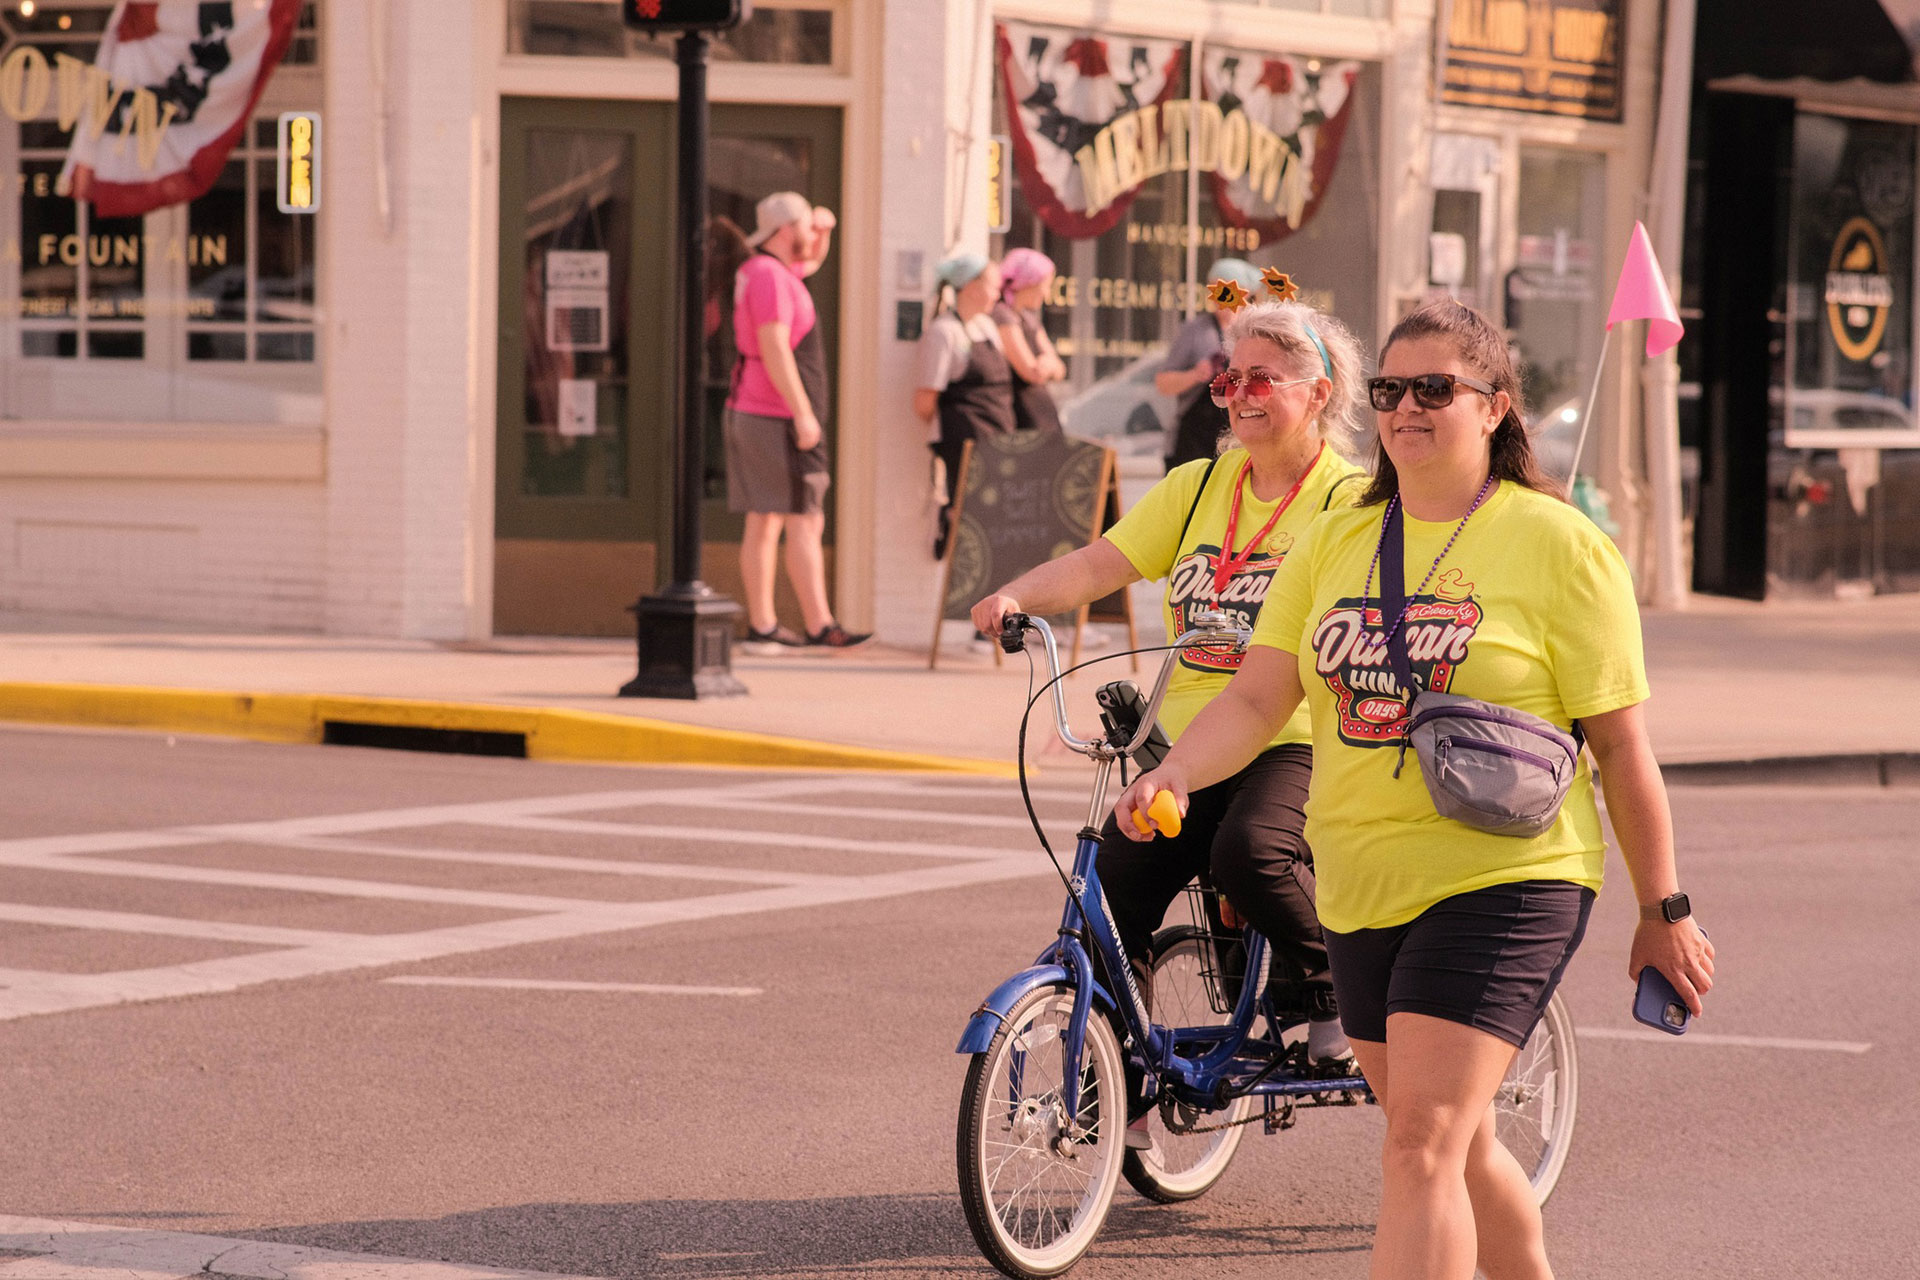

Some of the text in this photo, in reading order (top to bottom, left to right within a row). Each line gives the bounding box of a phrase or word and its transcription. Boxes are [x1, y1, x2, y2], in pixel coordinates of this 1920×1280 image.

[290, 116, 312, 208] OPEN
[1075, 99, 1310, 230] MELTDOWN
[37, 234, 228, 265] FOUNTAIN
[1088, 277, 1158, 309] CREAM
[1170, 555, 1271, 604] Dunca
[1313, 609, 1475, 673] Ducan
[1350, 668, 1423, 697] HINS
[1364, 701, 1401, 720] DAYS
